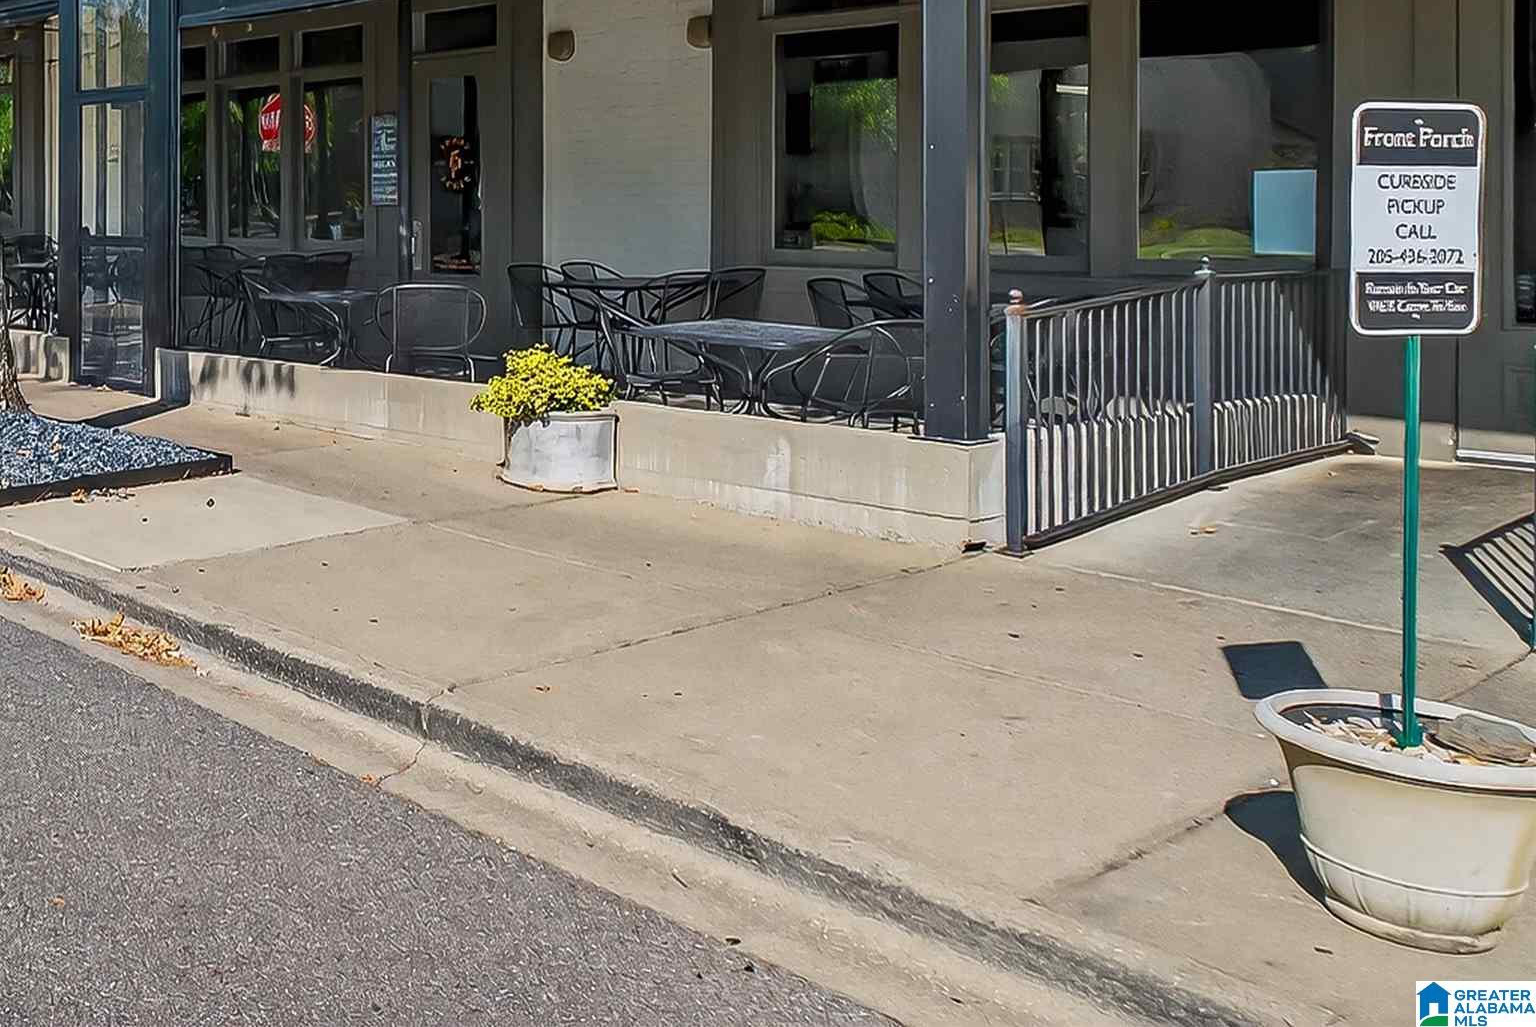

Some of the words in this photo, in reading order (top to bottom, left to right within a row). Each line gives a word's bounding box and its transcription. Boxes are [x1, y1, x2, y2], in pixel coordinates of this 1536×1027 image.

[1377, 173, 1457, 190] CURBSIDE
[1387, 198, 1445, 215] PICKUP
[1395, 223, 1437, 239] CALL
